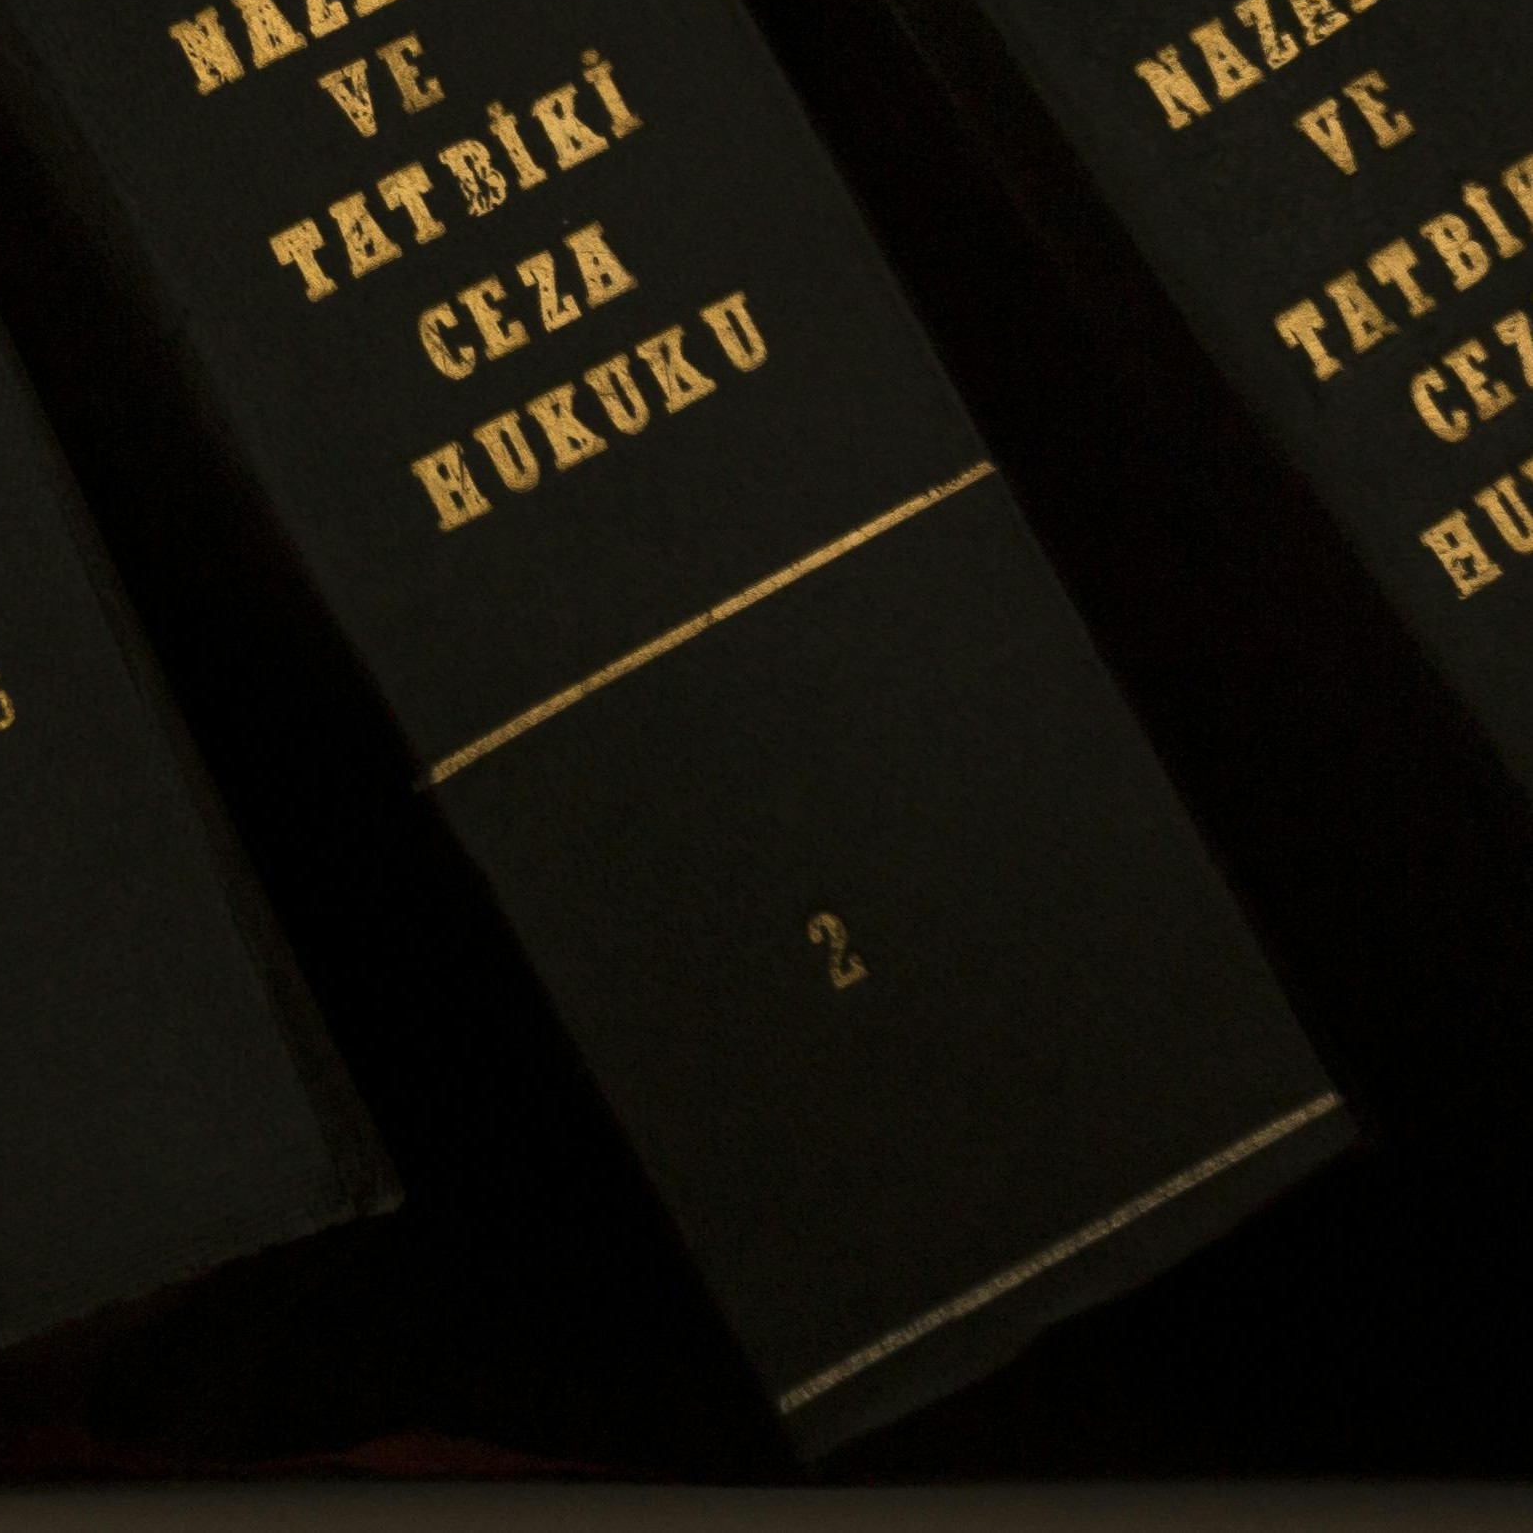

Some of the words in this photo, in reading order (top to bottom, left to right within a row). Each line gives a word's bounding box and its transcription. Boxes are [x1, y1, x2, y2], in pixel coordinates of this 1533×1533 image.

[316, 31, 447, 139] VE
[1294, 69, 1417, 176] VE
[268, 48, 644, 302] TATBİKİ
[417, 220, 639, 380] CEZA
[410, 290, 768, 533] HUKUKU
[807, 913, 869, 991] 2
